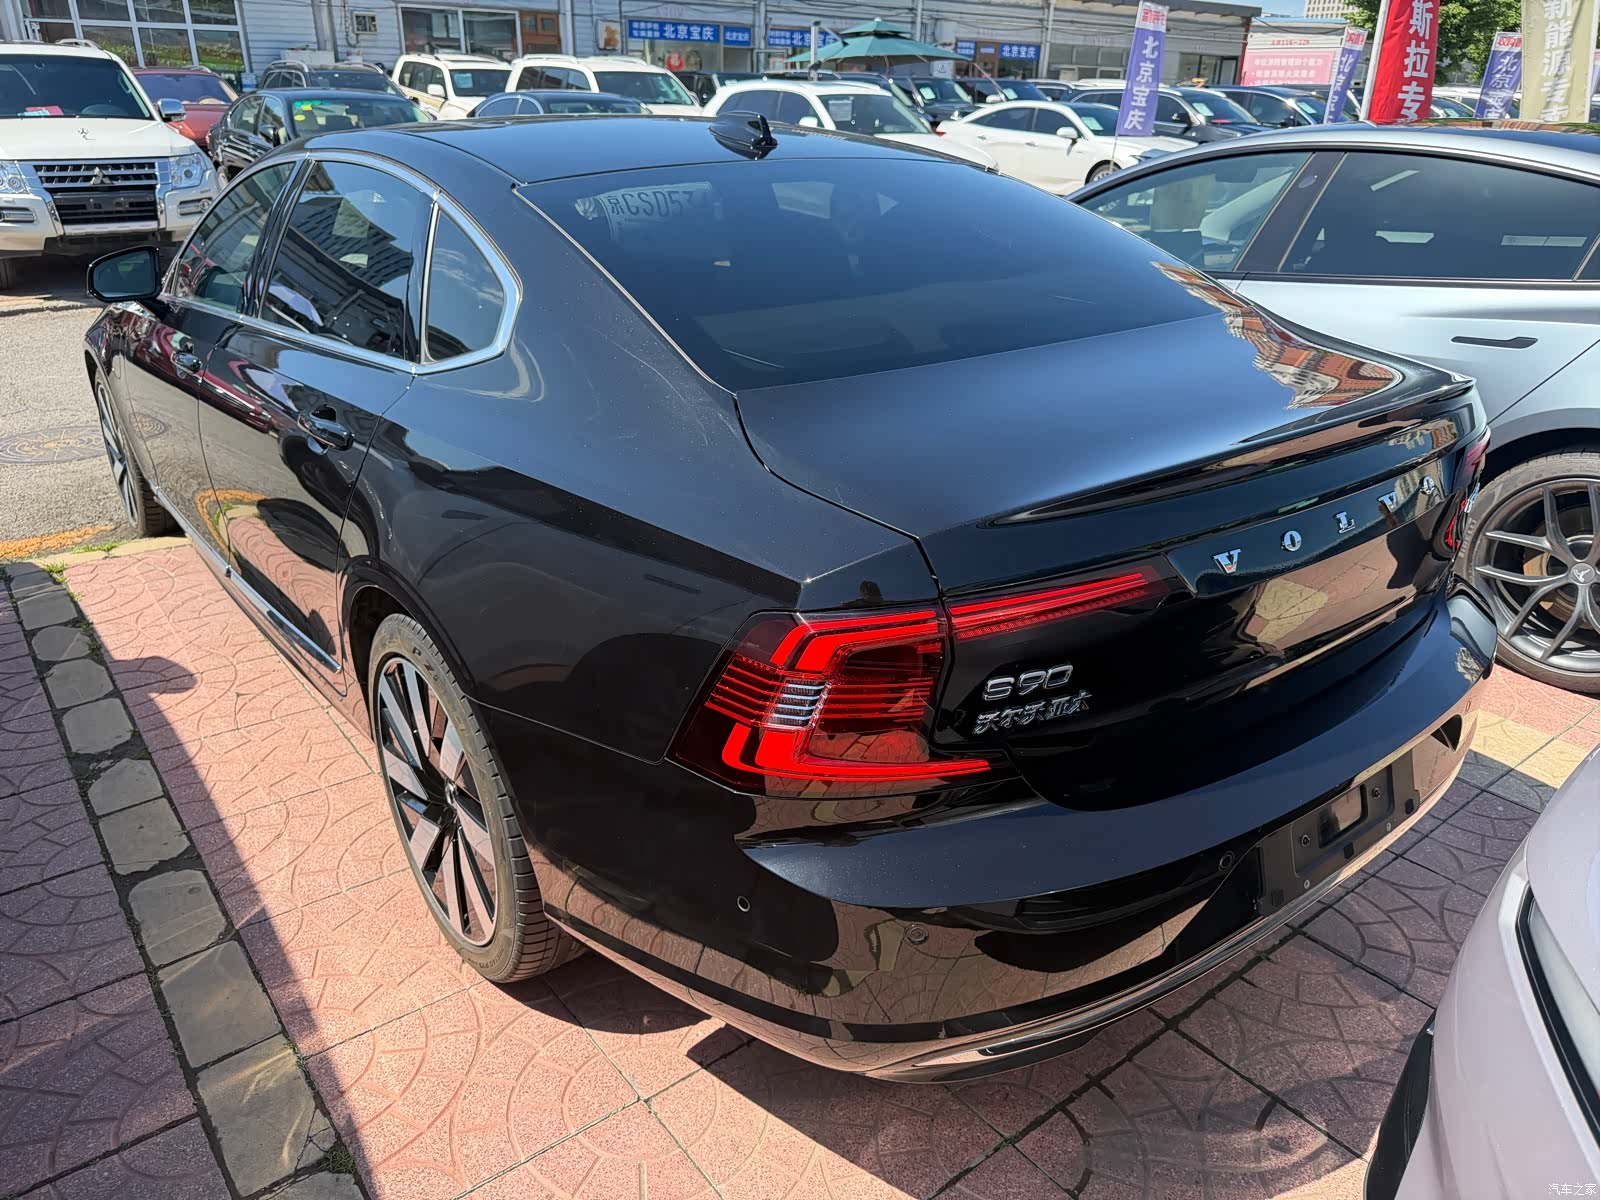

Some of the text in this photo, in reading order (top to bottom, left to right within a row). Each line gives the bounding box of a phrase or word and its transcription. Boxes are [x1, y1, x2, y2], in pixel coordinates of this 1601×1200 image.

[663, 23, 714, 40] 北京宝庆
[1002, 44, 1036, 58] 北京宝庆
[1124, 36, 1159, 130] 北京宝庆
[1212, 475, 1436, 575] VOLVO
[982, 664, 1074, 700] S90
[972, 690, 1093, 735] 沃尔沃亚太
